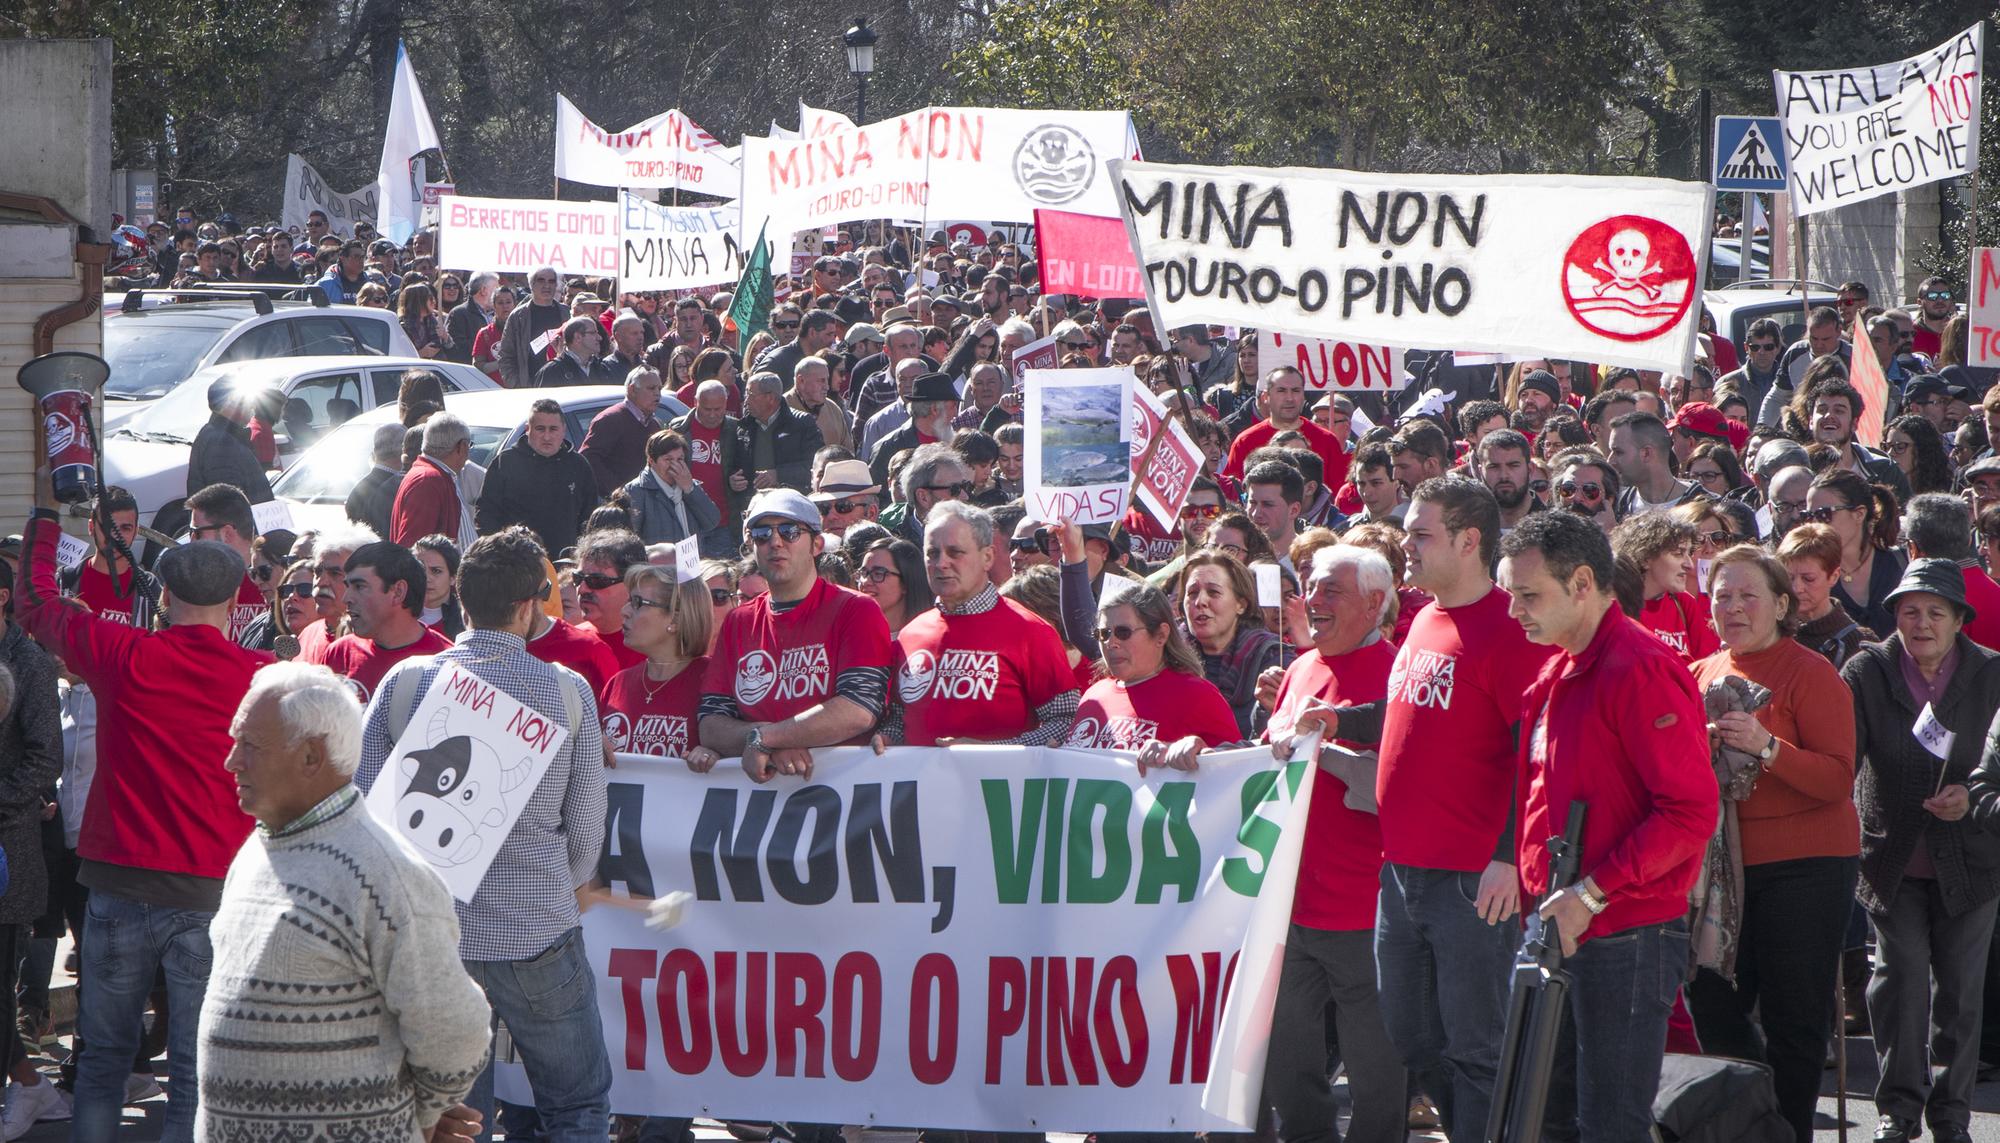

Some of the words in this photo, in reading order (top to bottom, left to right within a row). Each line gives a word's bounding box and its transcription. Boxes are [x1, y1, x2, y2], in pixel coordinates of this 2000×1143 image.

[1787, 121, 1847, 160] YOU
[1857, 101, 1906, 144] ARE
[767, 131, 873, 195] MINA
[898, 110, 984, 162] NON
[1793, 125, 1967, 204] WELCOME
[449, 203, 549, 232] BERREMOS
[556, 212, 605, 236] COMO
[1122, 179, 1292, 250] MINA
[1338, 189, 1487, 249] NON
[497, 241, 567, 268] MINA
[624, 236, 709, 279] MINA
[1046, 258, 1076, 288] EN
[1296, 342, 1393, 390] NON
[60, 540, 83, 556] MINA
[779, 647, 830, 673] MINA
[808, 665, 830, 675] PINO
[938, 653, 999, 673] MINA
[1409, 653, 1455, 680] MINA
[774, 672, 830, 700] NON
[932, 676, 999, 701] NON
[975, 670, 999, 680] PINO
[1432, 676, 1454, 688] PINO
[1400, 679, 1453, 710] NON
[443, 670, 497, 719] MINA
[506, 706, 558, 754] NON
[632, 734, 666, 743] TOURO-O
[667, 736, 689, 745] PINO
[633, 718, 688, 738] MINA
[1100, 718, 1158, 740] MINA
[690, 780, 957, 934] NON,
[980, 777, 1201, 905] VIDA
[607, 947, 882, 1083] TOURO
[908, 952, 960, 1085] O
[984, 954, 1150, 1088] PINO
